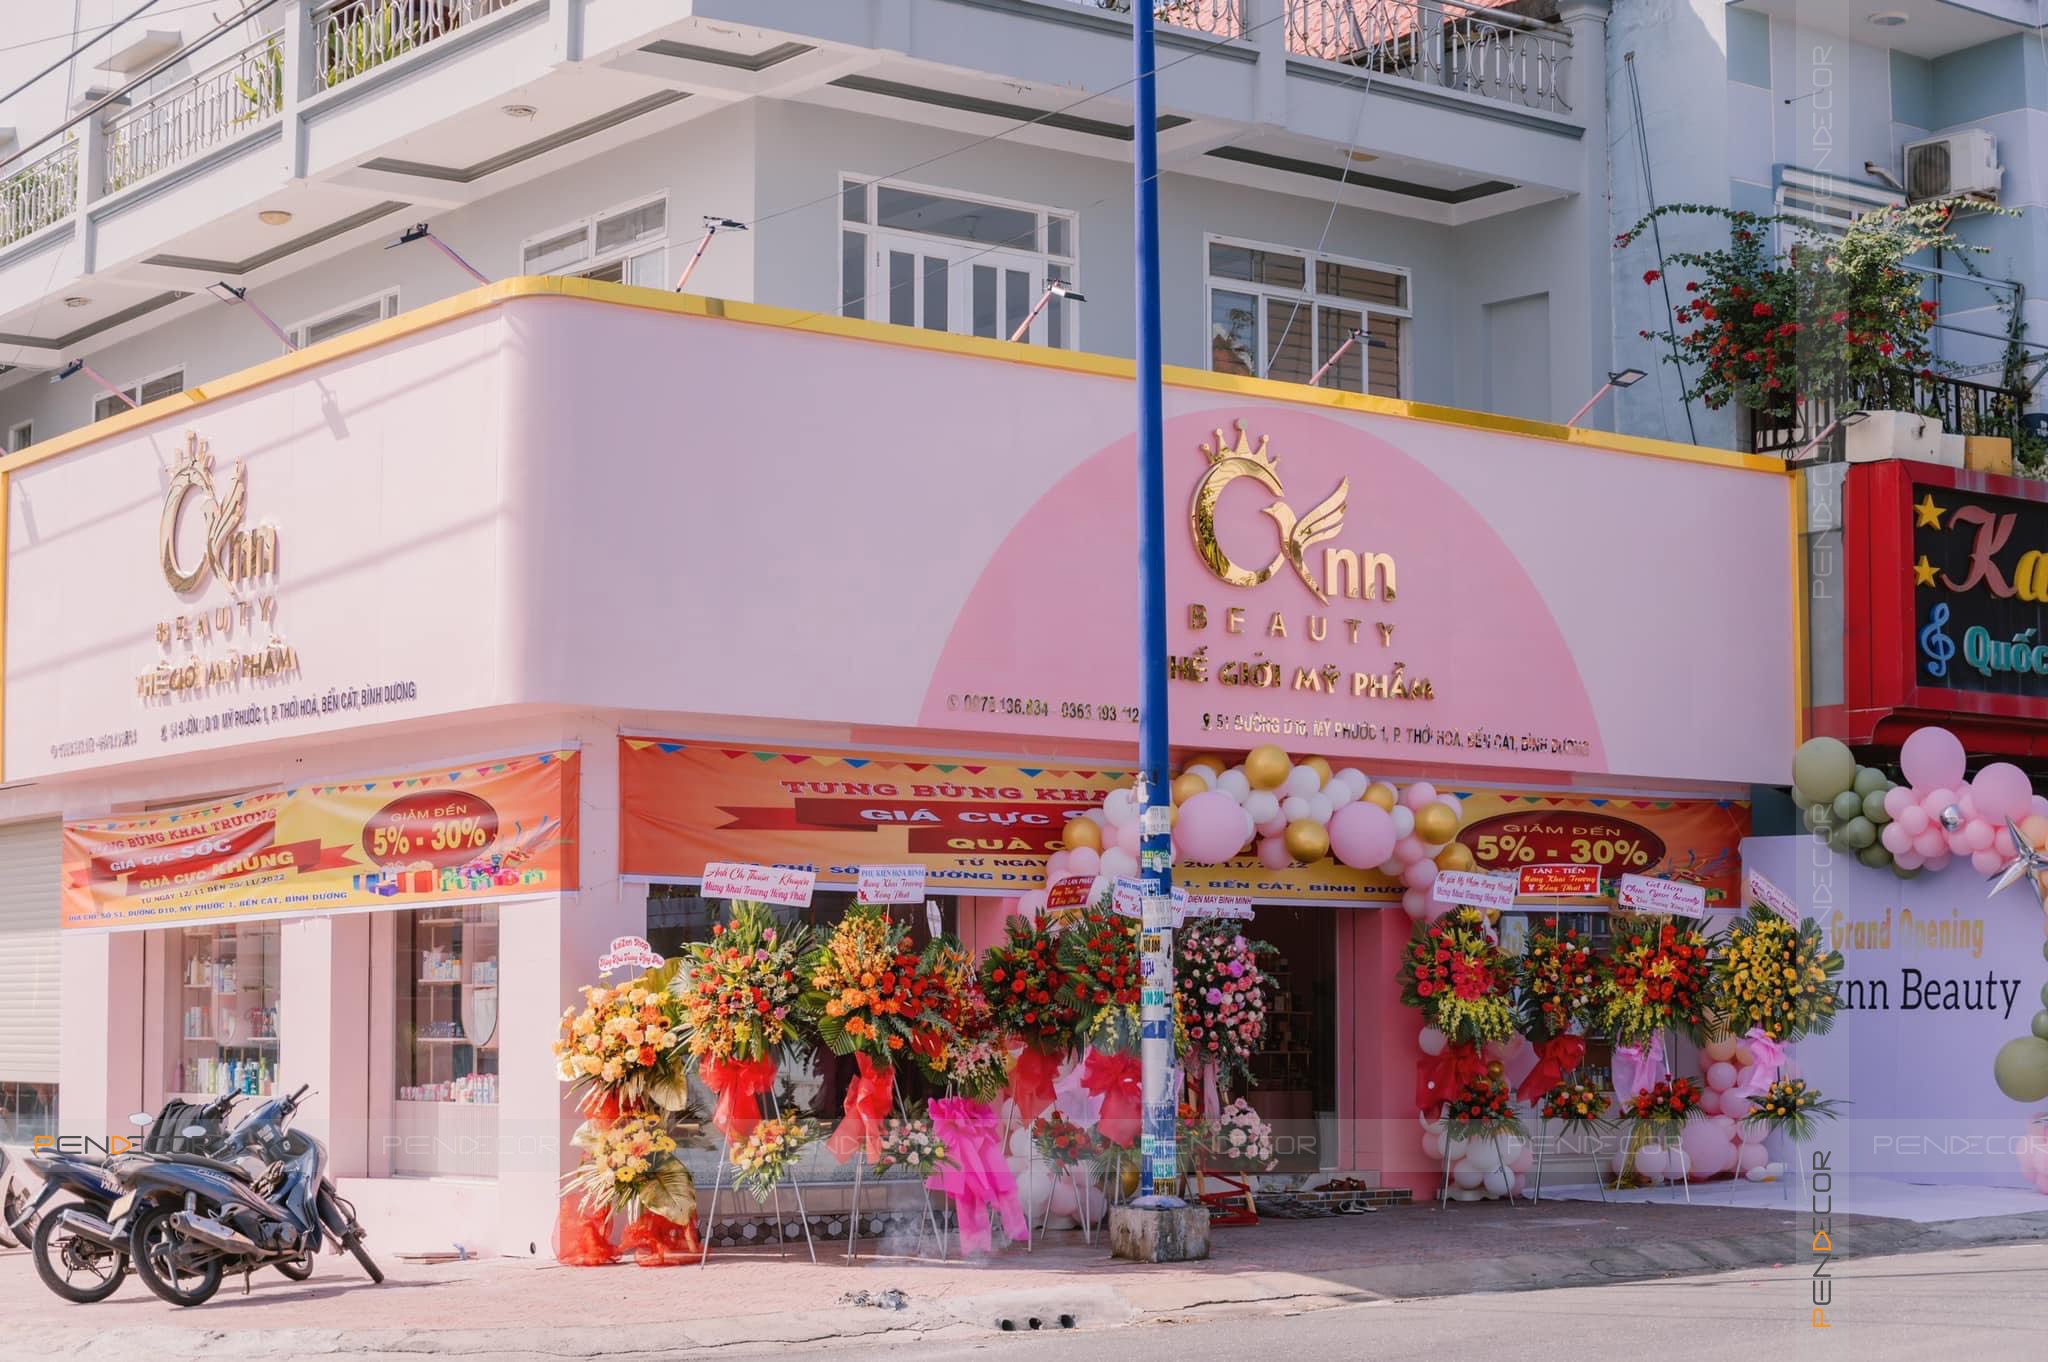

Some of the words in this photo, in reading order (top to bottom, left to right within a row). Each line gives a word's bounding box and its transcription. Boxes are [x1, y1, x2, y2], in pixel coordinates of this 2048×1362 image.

[1187, 603, 1396, 648] BEAUTY
[1964, 626, 2048, 678] Quốc
[1168, 646, 1209, 684] HẾ
[1219, 652, 1281, 688] GIỚI
[1292, 664, 1341, 694] MỸ
[1354, 661, 1435, 700] PHẨM
[390, 805, 430, 823] GIẢM
[434, 802, 468, 818] ĐẾN
[859, 808, 941, 822] GIÁ
[958, 810, 1050, 825] CỰC
[169, 824, 208, 840] KHAI
[373, 824, 411, 857] 5%
[430, 816, 487, 851] 30%
[1503, 822, 1564, 835] GIẢM
[1573, 823, 1621, 837] ĐẾN
[946, 836, 1032, 851] QUÀ
[1477, 835, 1536, 863] 5%
[1570, 838, 1649, 866] 30%
[954, 856, 985, 868] TỪ
[139, 874, 171, 890] QUÀ
[1208, 879, 1250, 889] BẾN
[1309, 882, 1355, 893] BÌNH
[1831, 906, 1892, 950] Grand
[1900, 967, 2022, 1020] Beauty
